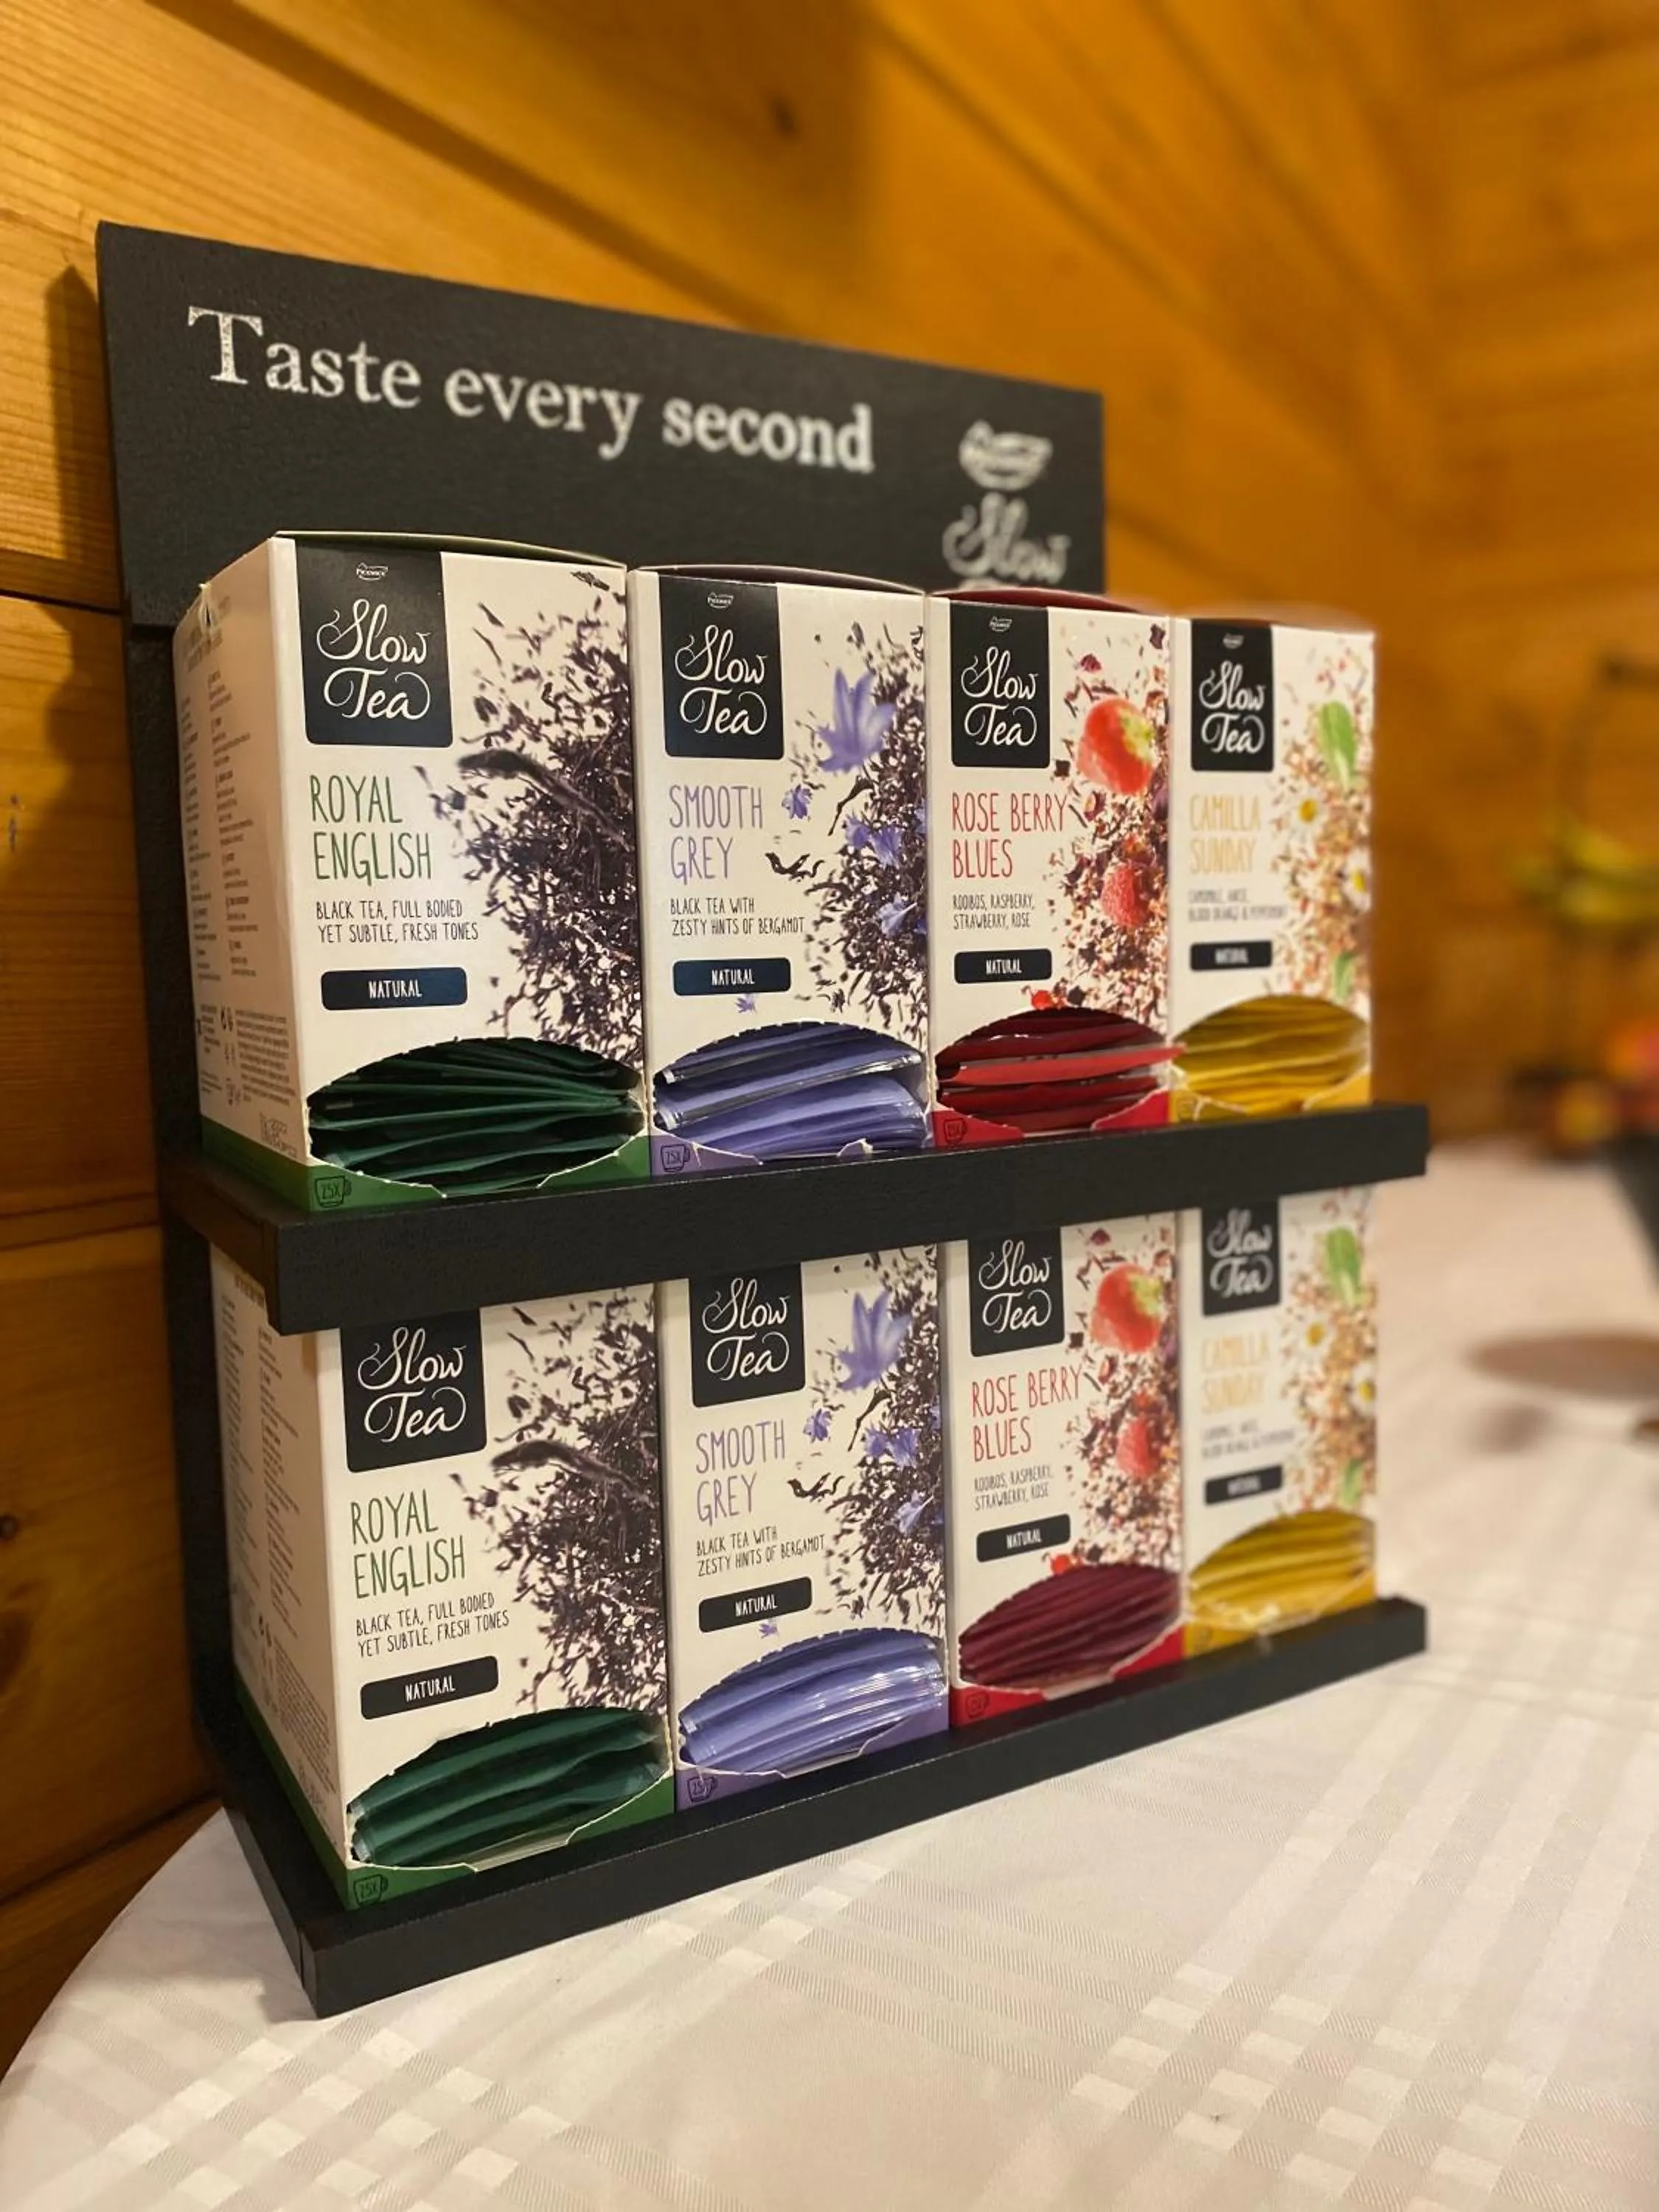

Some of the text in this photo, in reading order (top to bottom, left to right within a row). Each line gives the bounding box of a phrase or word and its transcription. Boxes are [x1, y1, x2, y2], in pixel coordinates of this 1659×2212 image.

[188, 305, 422, 408] Taste
[444, 368, 641, 460] every
[663, 396, 875, 474] second
[316, 599, 431, 664] Slow
[675, 625, 768, 684] Slow
[324, 667, 431, 720] Tea
[961, 646, 1039, 700] Slow
[1199, 660, 1266, 712] Slow
[680, 686, 768, 735] Tea
[964, 702, 1037, 746] Tea
[1201, 712, 1265, 754] Tea
[309, 775, 403, 824] ROYAL
[669, 785, 763, 830] SMOOTH
[951, 791, 1067, 832] ROSE BERRY
[1189, 794, 1261, 831] CAMILLA
[313, 832, 432, 886] ENGLISH
[670, 835, 734, 885] GREY
[953, 838, 1012, 878] BLUES
[1189, 838, 1256, 874] SUNDAY
[316, 899, 462, 921] BLACK TEA, FULL BODIED
[670, 897, 755, 915] BLACK TEA WITH
[672, 917, 805, 936] ZESTY HINTS OF BERGAMOT
[1012, 912, 1031, 928] ROSE
[318, 922, 479, 944] YET SUBTLE, FRESH TONES
[368, 979, 422, 999] NATURAL
[712, 969, 755, 987] NATURAL
[986, 959, 1023, 975] NATURAL
[978, 1239, 1052, 1290] Slow
[702, 1278, 790, 1334] Slow
[982, 1289, 1051, 1333] Tea
[358, 1326, 467, 1390] Slow
[707, 1331, 790, 1381] Tea
[971, 1364, 1082, 1418] ROSE BERRY
[364, 1386, 467, 1443] Tea
[696, 1419, 785, 1474] SMOOTH
[973, 1416, 1032, 1463] BLUES
[350, 1488, 439, 1545] ROYAL
[697, 1471, 757, 1527] GREY
[696, 1526, 778, 1557] BLACK TEA WITH
[697, 1534, 825, 1577] ZESTY HINTS OF BERGAMOT
[1006, 1528, 1043, 1549] NATURAL
[353, 1534, 465, 1599] ENGLISH
[356, 1592, 495, 1636] BLACK TEA, FULL BODIED
[735, 1593, 778, 1617] NATURAL
[358, 1610, 509, 1658] YET SUBTLE, FRESH TONES
[405, 1675, 456, 1703] NATURAL
